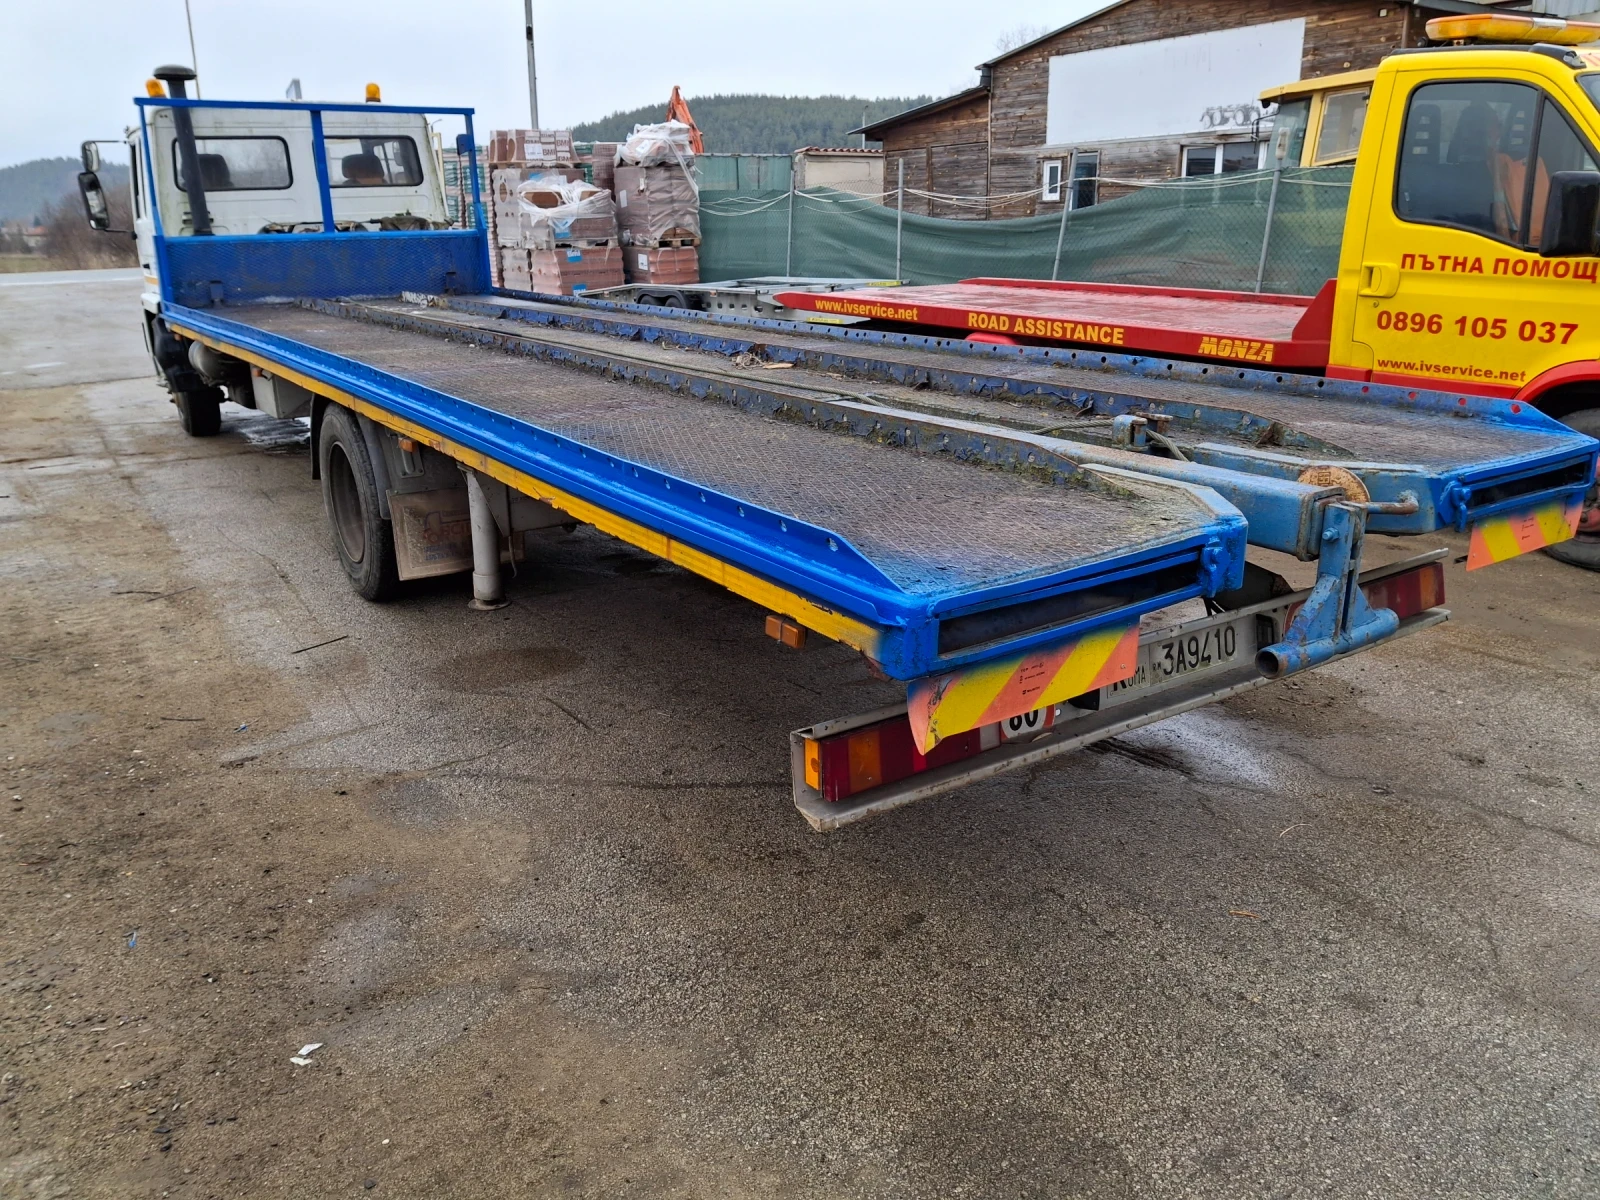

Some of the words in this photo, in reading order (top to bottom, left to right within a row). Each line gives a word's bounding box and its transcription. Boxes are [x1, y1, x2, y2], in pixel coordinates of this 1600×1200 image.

[1401, 253, 1483, 274] ПЪТНА
[1492, 258, 1598, 284] ПОМОЩ
[814, 299, 918, 321] www.ivservice.net
[968, 312, 1010, 331] ROAD
[1013, 317, 1124, 345] ASSISTANCE
[1377, 310, 1443, 334] 0896
[1454, 315, 1507, 339] 105
[1518, 320, 1579, 345] 037
[1197, 336, 1274, 362] MONZA
[1377, 358, 1526, 382] www.ivservice.net
[1162, 625, 1236, 676] 3A9410
